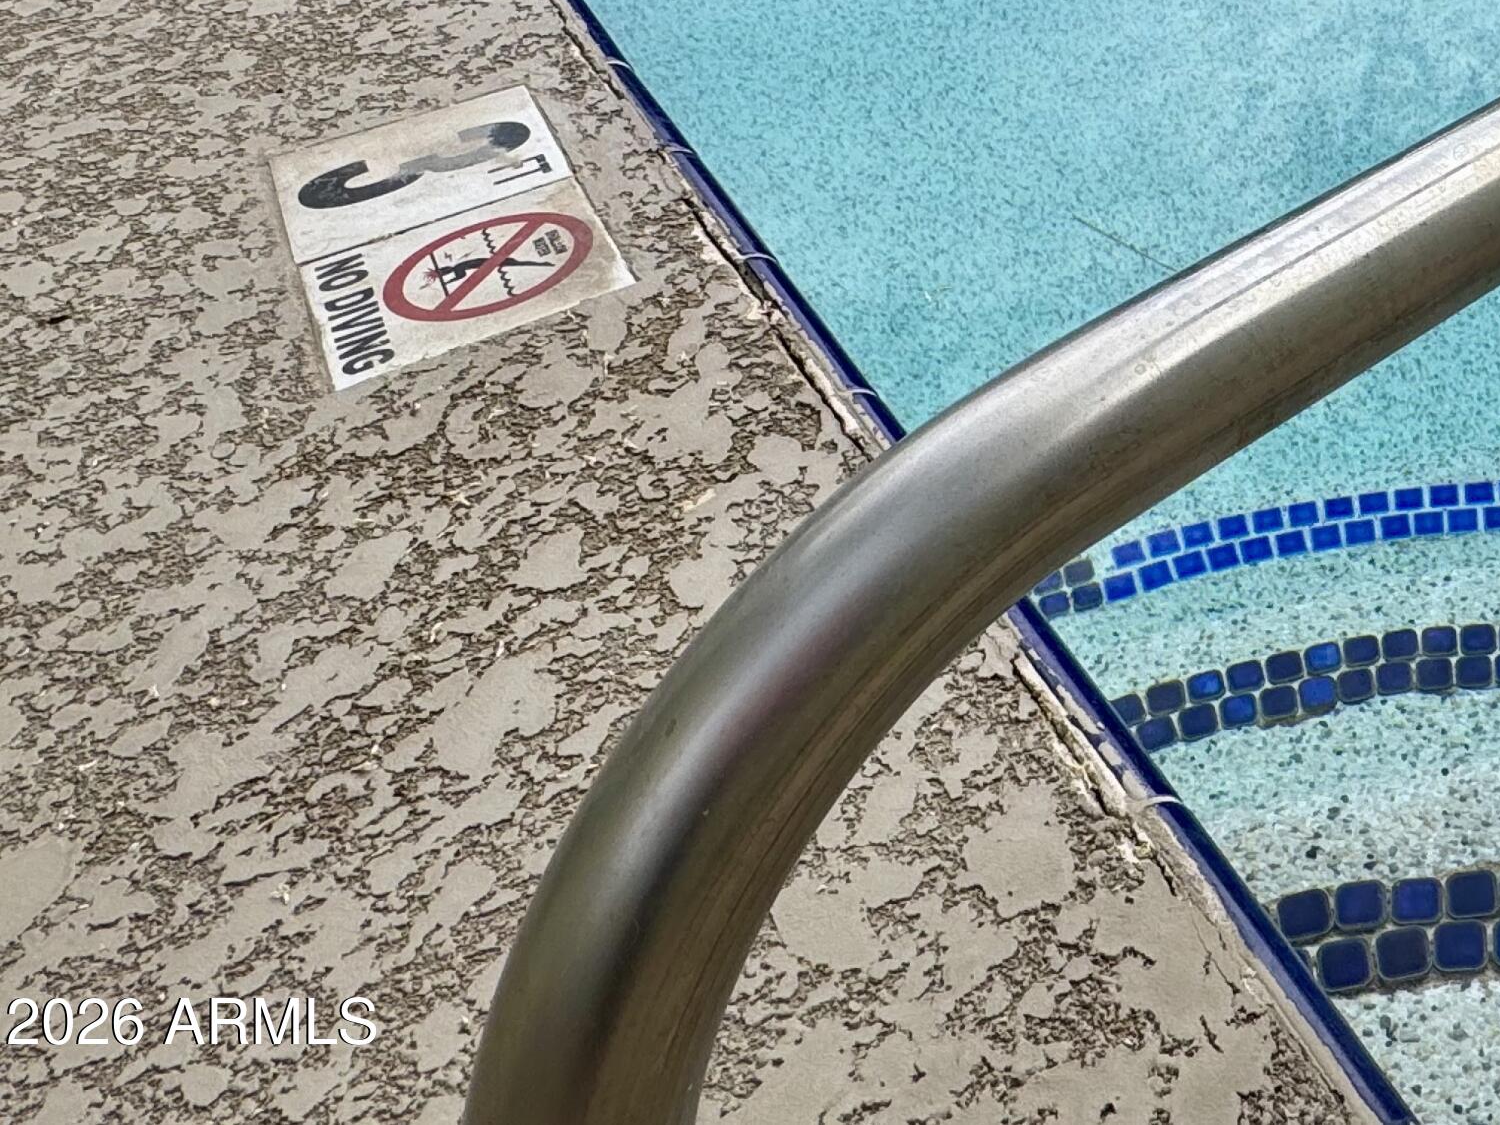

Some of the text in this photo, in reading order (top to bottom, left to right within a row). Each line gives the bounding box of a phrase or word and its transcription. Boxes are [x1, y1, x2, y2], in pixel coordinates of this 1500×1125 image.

[298, 121, 554, 209] 3 FT
[314, 253, 396, 376] NO DIVING
